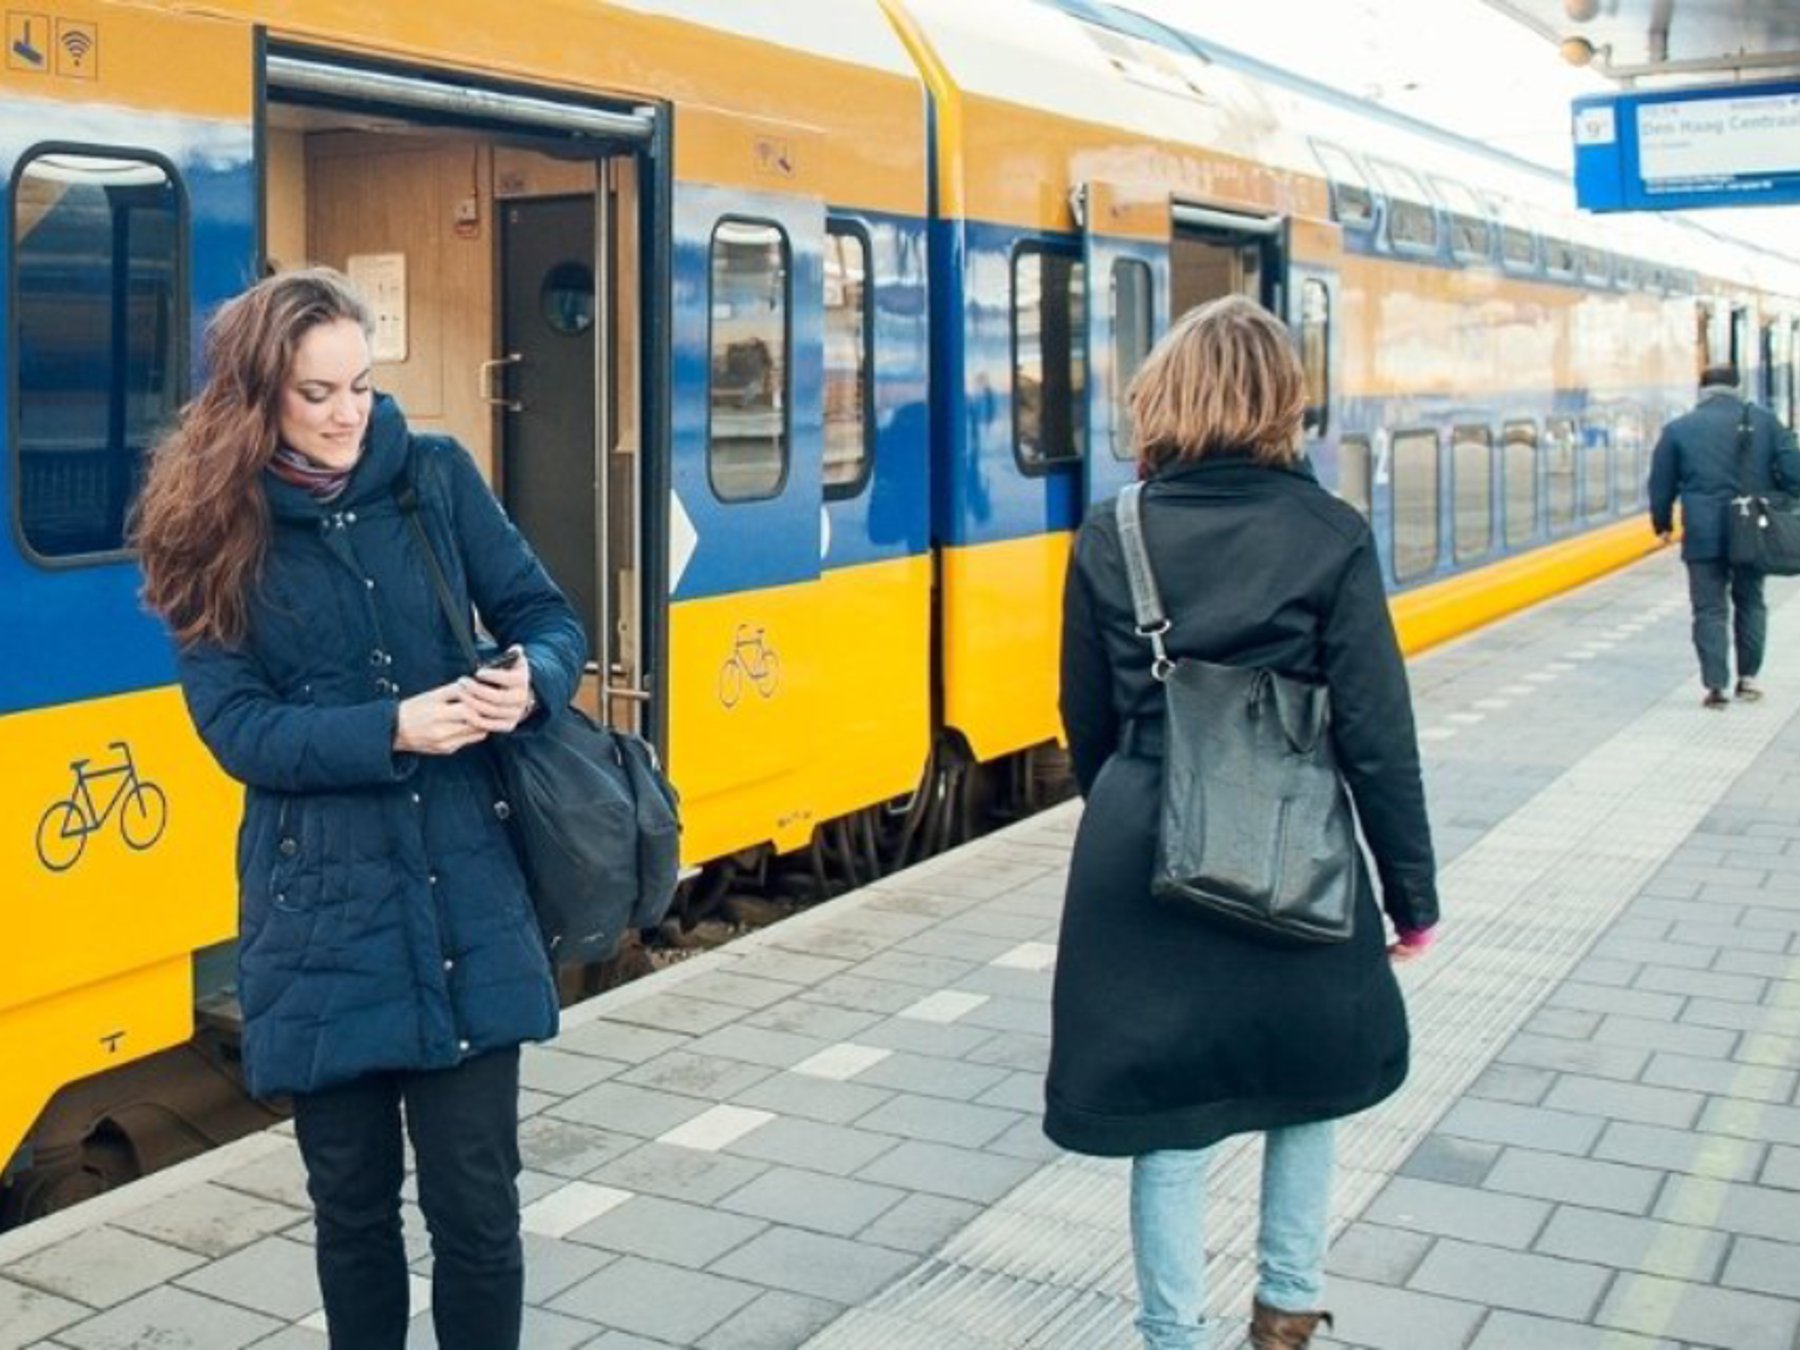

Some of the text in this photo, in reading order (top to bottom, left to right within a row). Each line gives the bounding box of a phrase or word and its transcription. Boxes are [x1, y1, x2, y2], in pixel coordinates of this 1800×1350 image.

[1641, 121, 1675, 136] Den
[1681, 119, 1723, 136] Haag
[1373, 428, 1390, 484] 2
